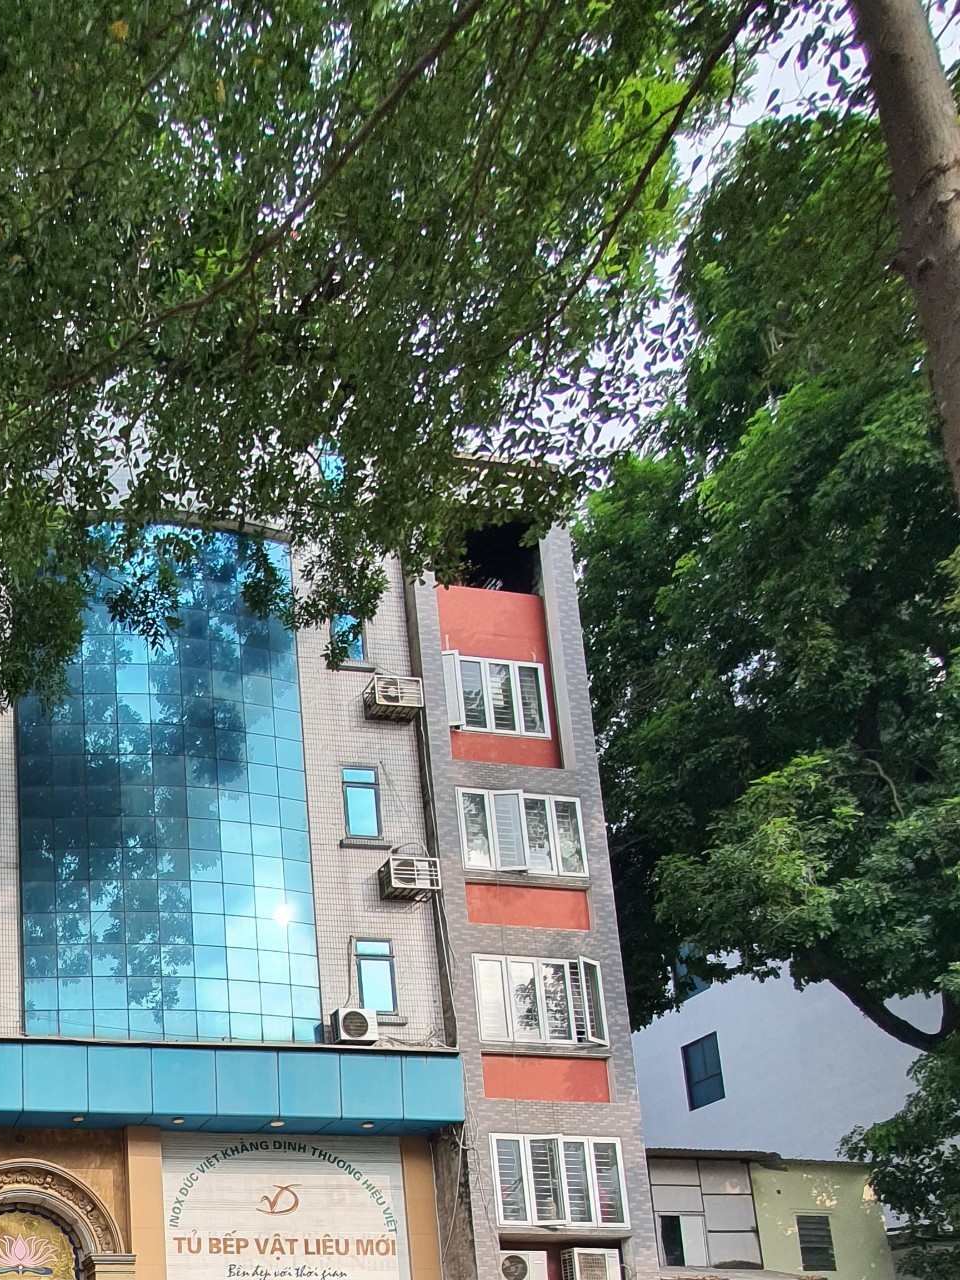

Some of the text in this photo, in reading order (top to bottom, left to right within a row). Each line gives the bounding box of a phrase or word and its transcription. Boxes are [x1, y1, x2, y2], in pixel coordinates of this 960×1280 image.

[169, 1197, 185, 1228] INOX
[196, 1153, 221, 1174] VIỆT
[310, 1146, 363, 1181] THƯƠNG
[361, 1179, 387, 1206] HIỆU
[173, 1229, 202, 1255] TỦ
[208, 1230, 249, 1255] BẾP
[254, 1233, 298, 1260] VẬT
[356, 1234, 396, 1256] MỚI
[227, 1263, 250, 1278] Bền
[274, 1267, 292, 1278] với
[294, 1265, 318, 1278] thời
